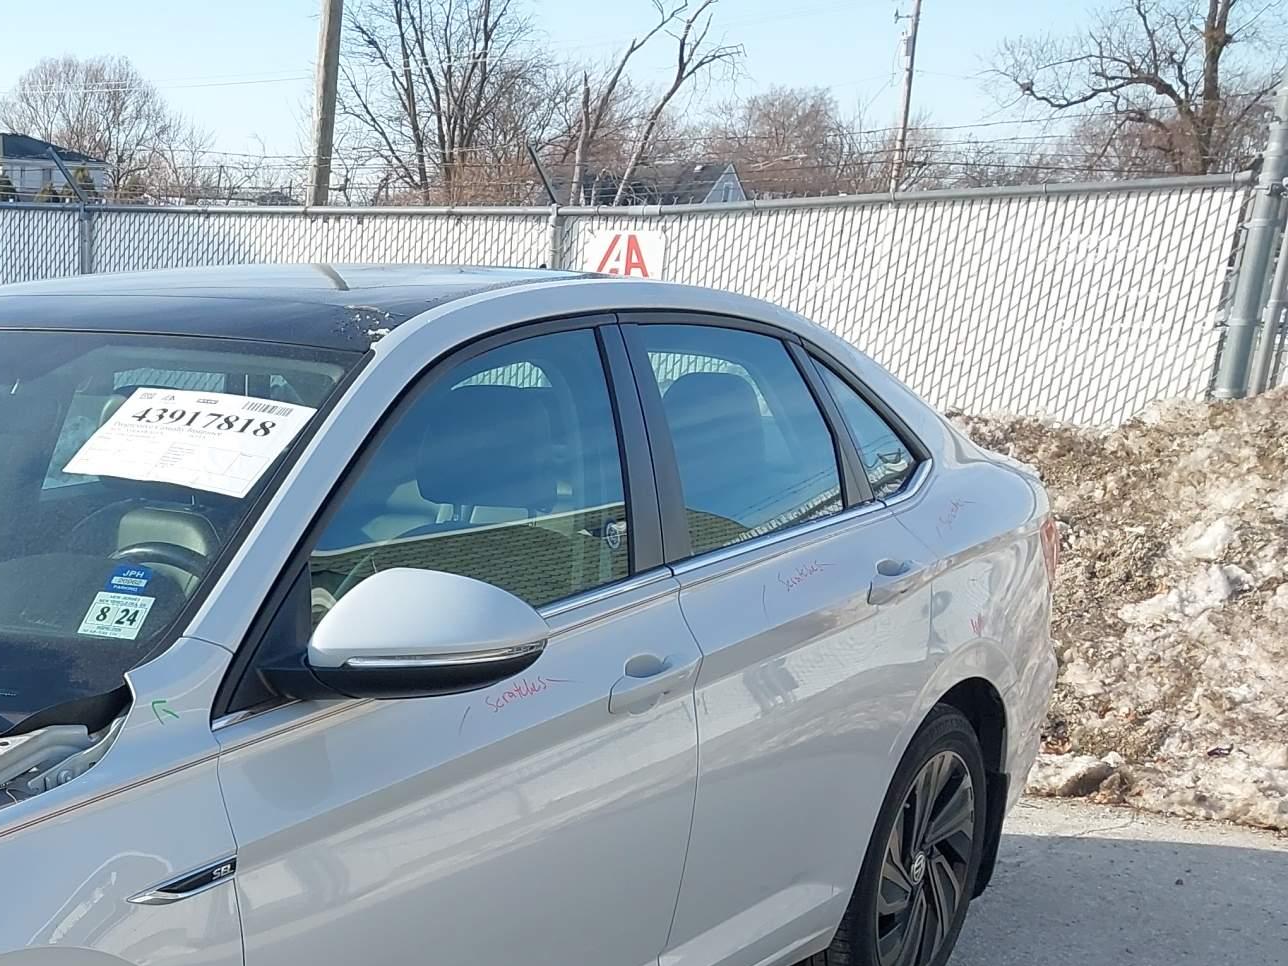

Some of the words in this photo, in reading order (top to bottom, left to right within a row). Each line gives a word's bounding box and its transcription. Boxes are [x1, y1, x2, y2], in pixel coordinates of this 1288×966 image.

[131, 406, 276, 437] 43917818
[122, 569, 145, 578] JPH
[95, 606, 111, 622] 8
[115, 608, 140, 626] 24
[212, 864, 233, 880] SEL
